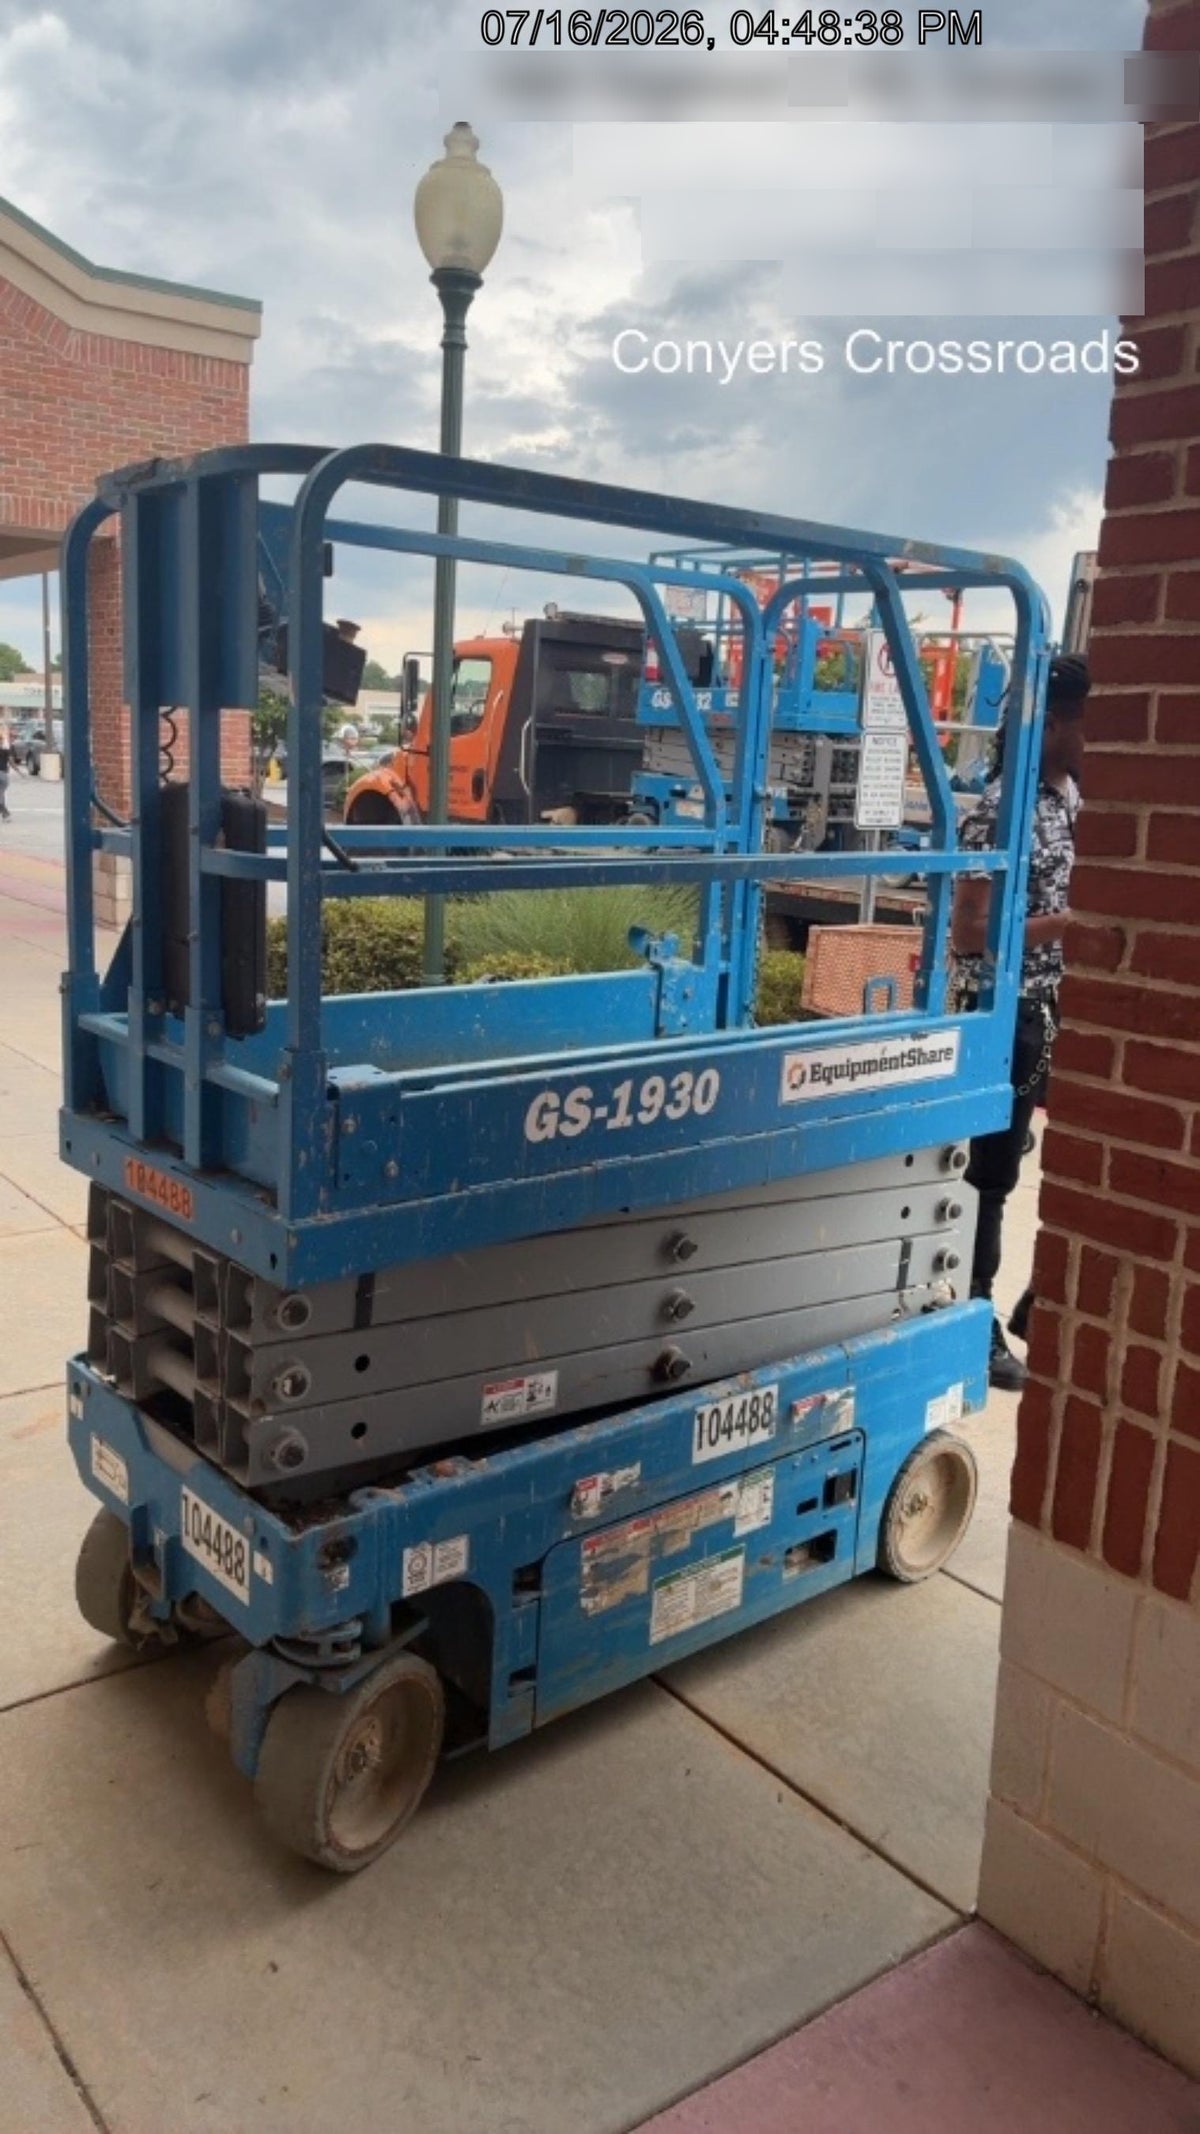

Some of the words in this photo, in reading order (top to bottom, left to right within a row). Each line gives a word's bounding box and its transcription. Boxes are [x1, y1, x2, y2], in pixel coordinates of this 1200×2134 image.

[809, 1047, 954, 1085] EquipmentShare
[523, 1068, 720, 1143] GS-1930
[126, 1160, 191, 1220] 104488
[695, 1391, 775, 1451] 104488
[182, 1493, 246, 1587] 104488
